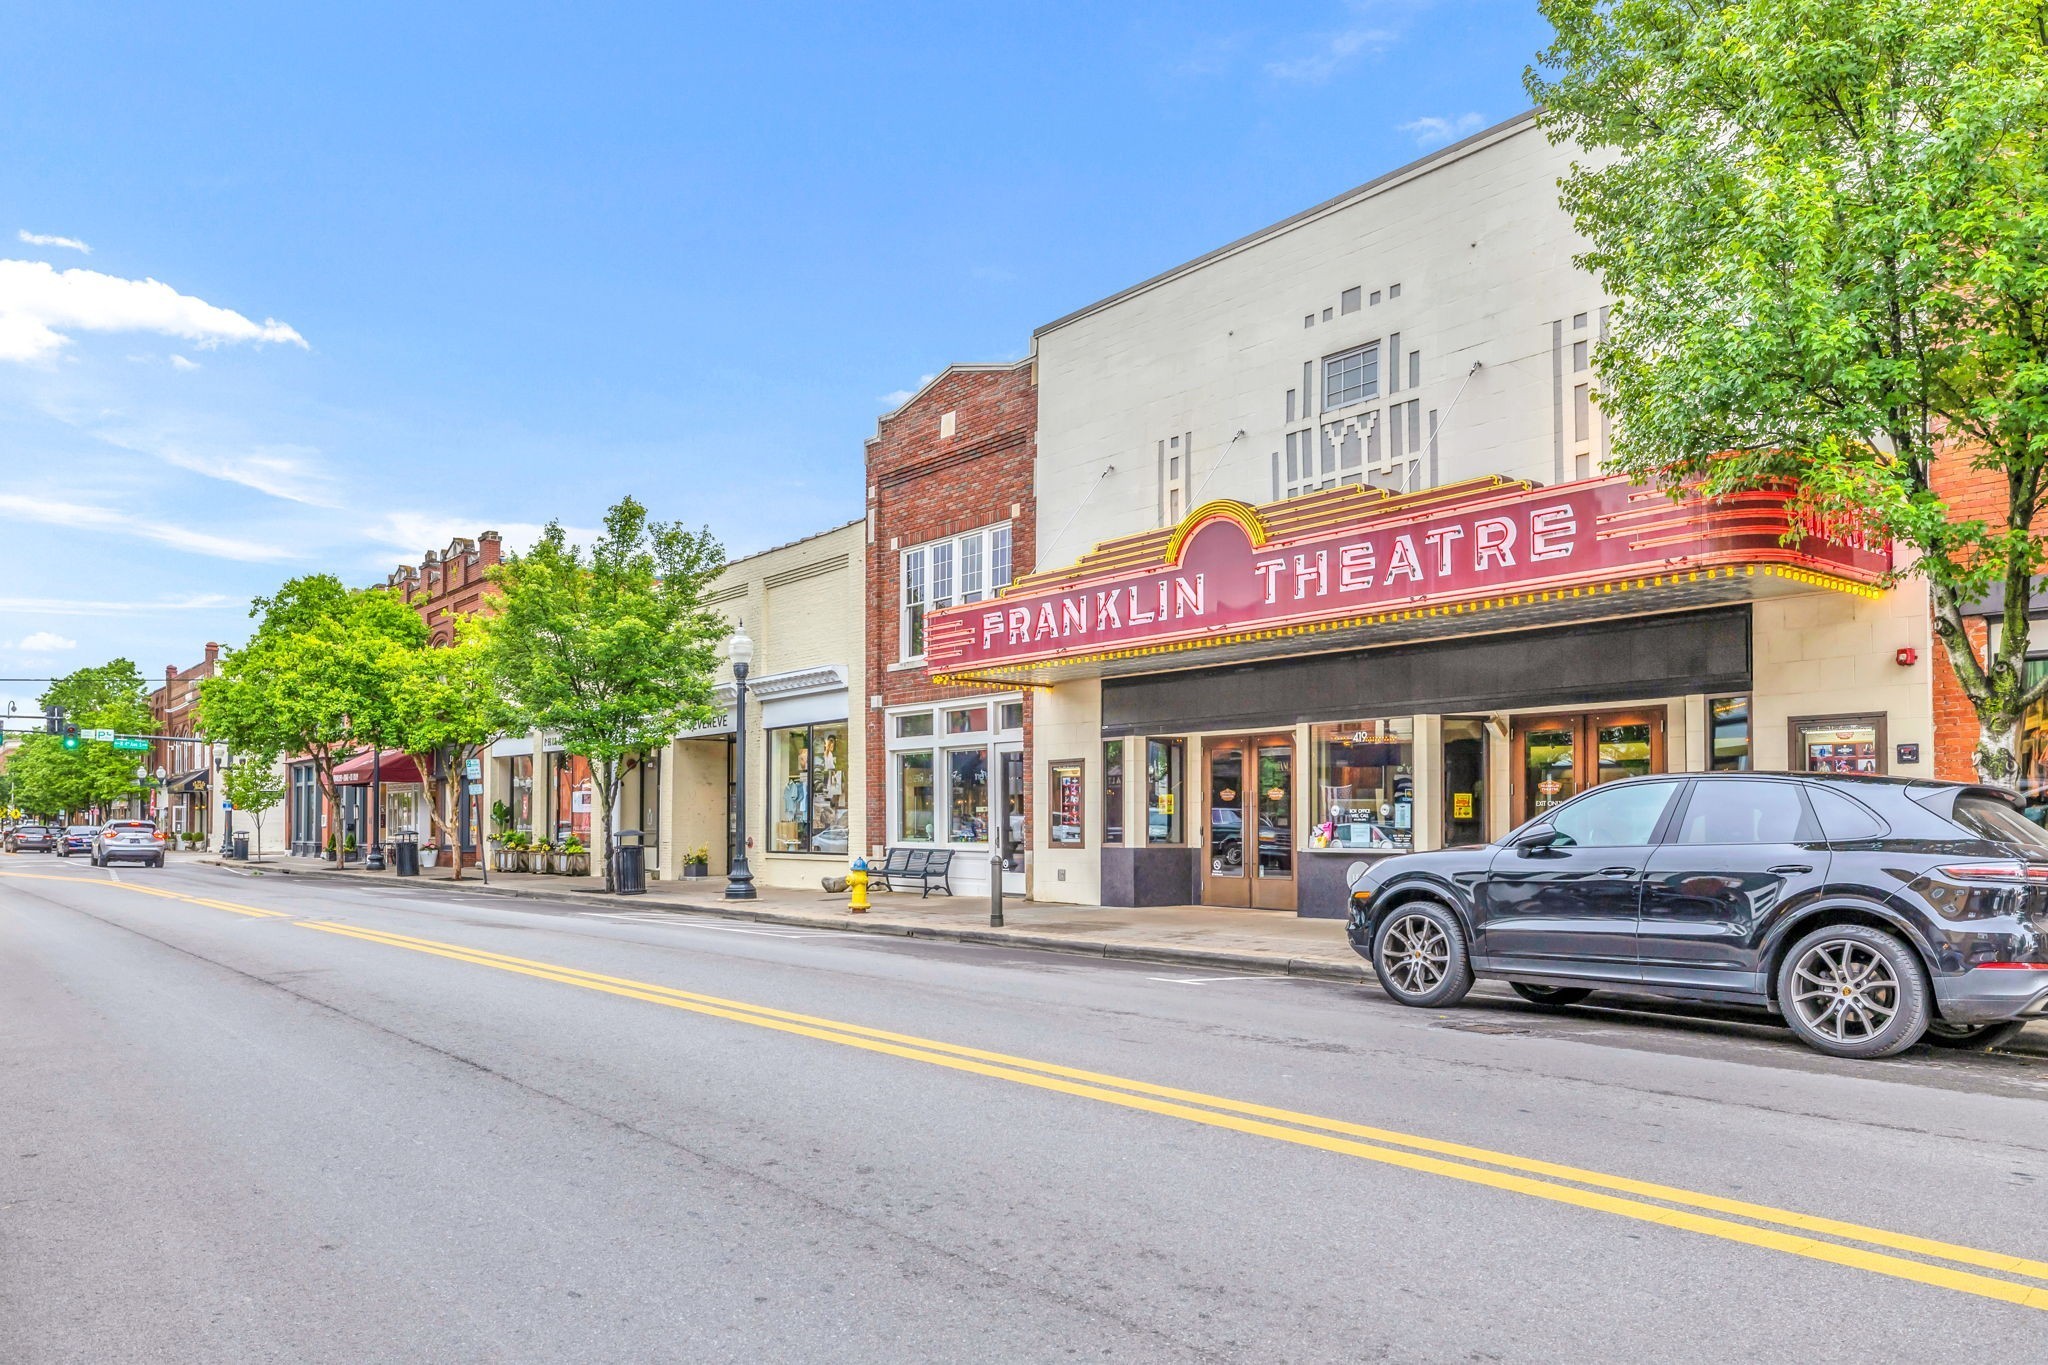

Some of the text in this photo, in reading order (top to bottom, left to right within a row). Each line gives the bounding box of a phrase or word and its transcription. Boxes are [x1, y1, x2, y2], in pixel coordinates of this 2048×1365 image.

[982, 503, 1577, 650] FRANKLIN THEATRE
[1352, 731, 1368, 742] 419
